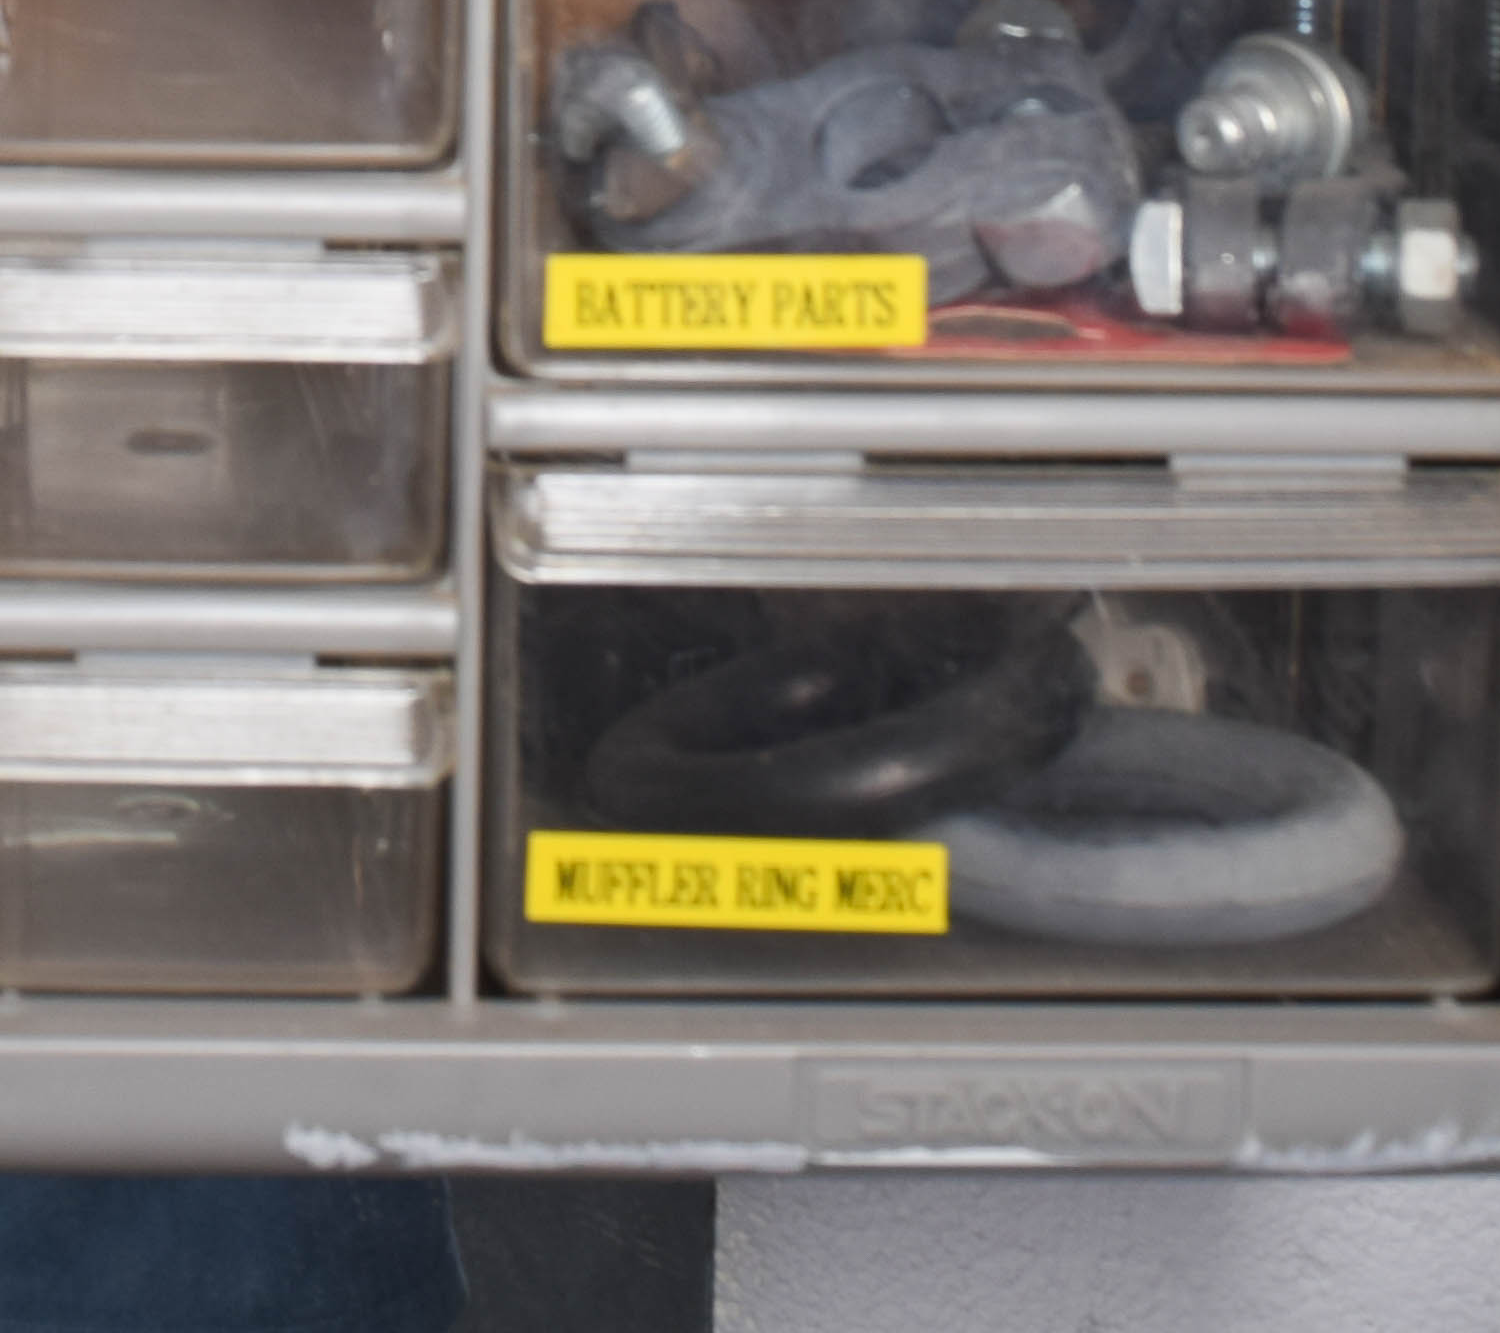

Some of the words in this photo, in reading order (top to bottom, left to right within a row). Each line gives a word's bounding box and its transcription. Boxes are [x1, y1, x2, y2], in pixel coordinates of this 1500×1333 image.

[572, 280, 763, 327] BATTERY
[771, 278, 900, 327] PARTS
[555, 859, 721, 909] MUFFLER
[736, 862, 819, 912] RING
[834, 866, 935, 916] MERC
